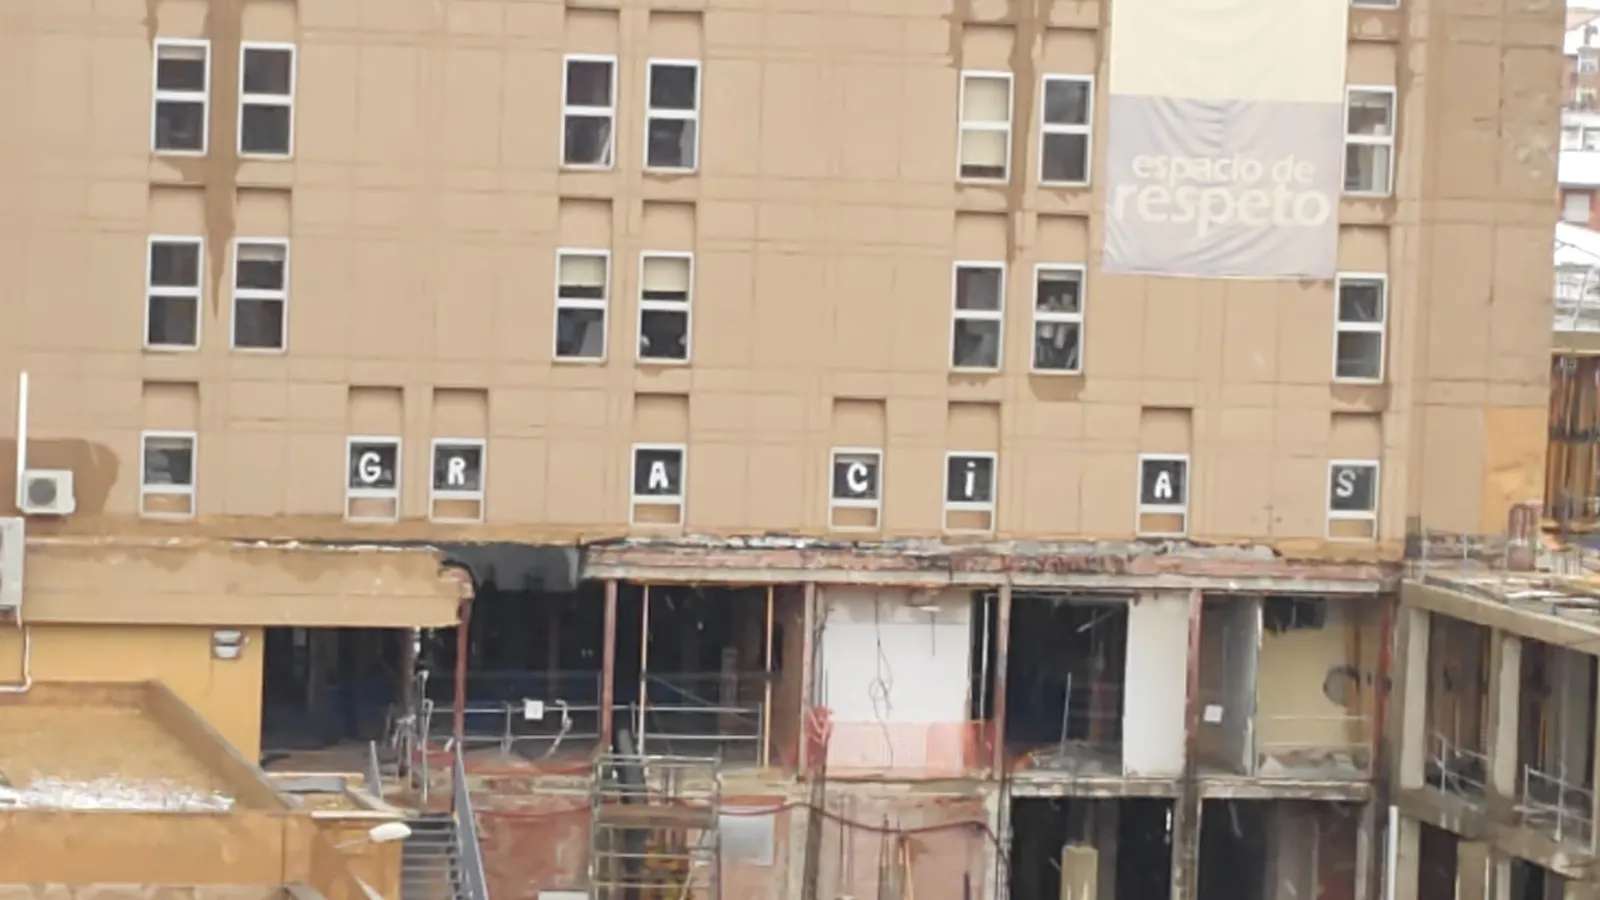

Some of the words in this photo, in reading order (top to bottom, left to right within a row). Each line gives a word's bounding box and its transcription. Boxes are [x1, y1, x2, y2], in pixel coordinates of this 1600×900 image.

[1132, 152, 1263, 188] espacio
[1272, 154, 1317, 183] de
[1114, 183, 1331, 239] respeto
